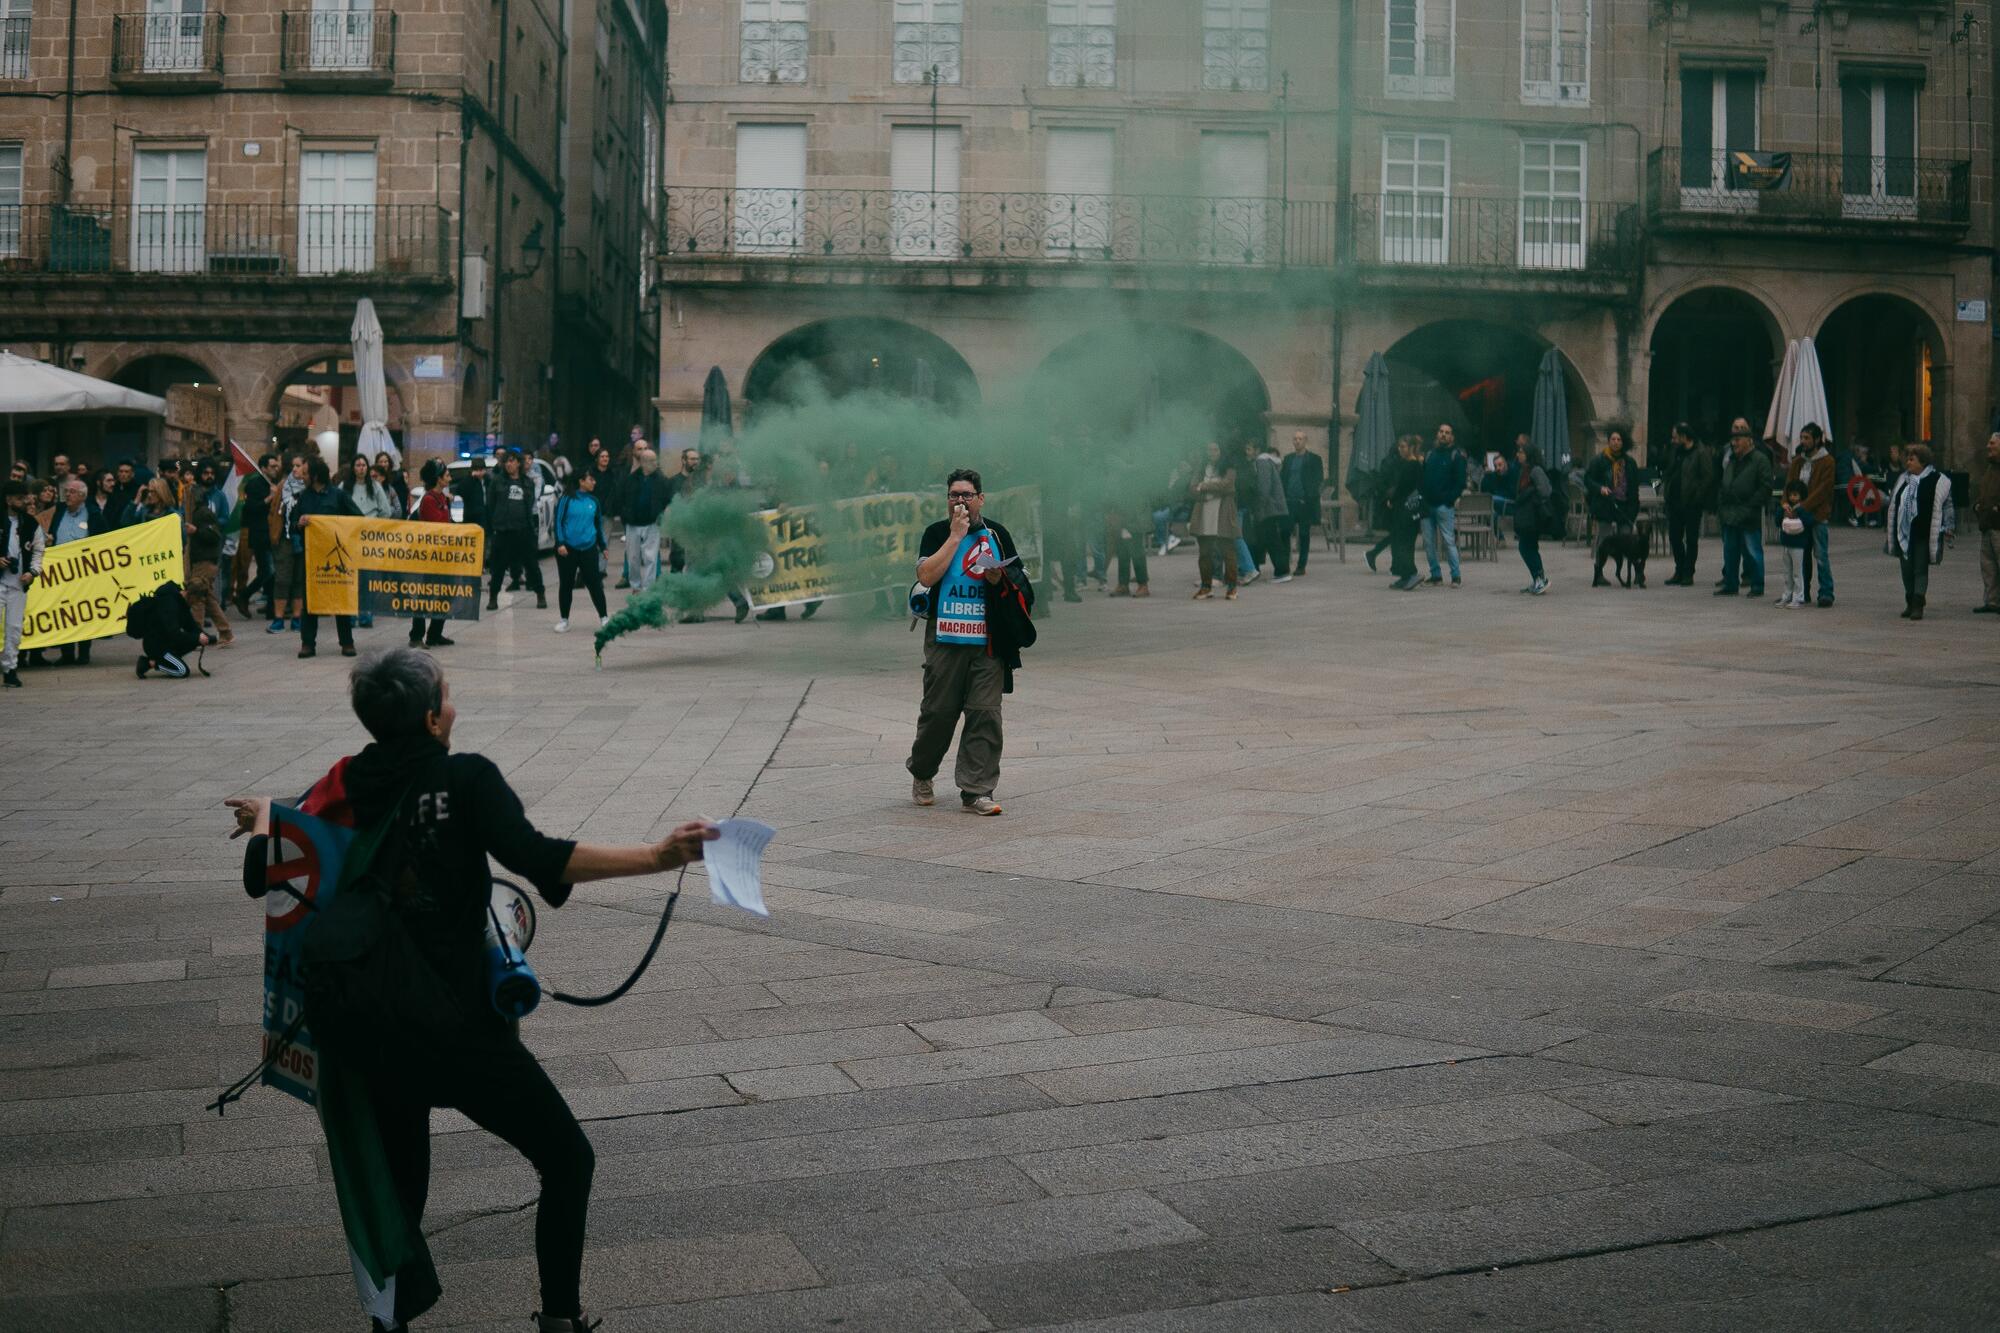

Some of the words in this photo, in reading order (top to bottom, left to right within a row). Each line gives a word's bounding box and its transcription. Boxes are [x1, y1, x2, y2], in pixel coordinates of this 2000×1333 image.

[361, 529, 402, 543] SOMOS
[406, 532, 414, 544] O
[417, 533, 477, 548] PRESENTE
[139, 550, 175, 567] TERRA
[362, 546, 385, 558] DAS
[388, 548, 427, 561] NOSAS
[430, 551, 476, 564] ALDEAS
[40, 545, 132, 588] MUIÑOS
[153, 569, 167, 581] DE
[368, 580, 398, 594] IMOS
[400, 582, 473, 598] CONSERVAR
[948, 584, 985, 599] ALDE
[392, 598, 400, 610] O
[403, 599, 451, 613] FUTURO
[23, 597, 111, 637] UCIÑOS
